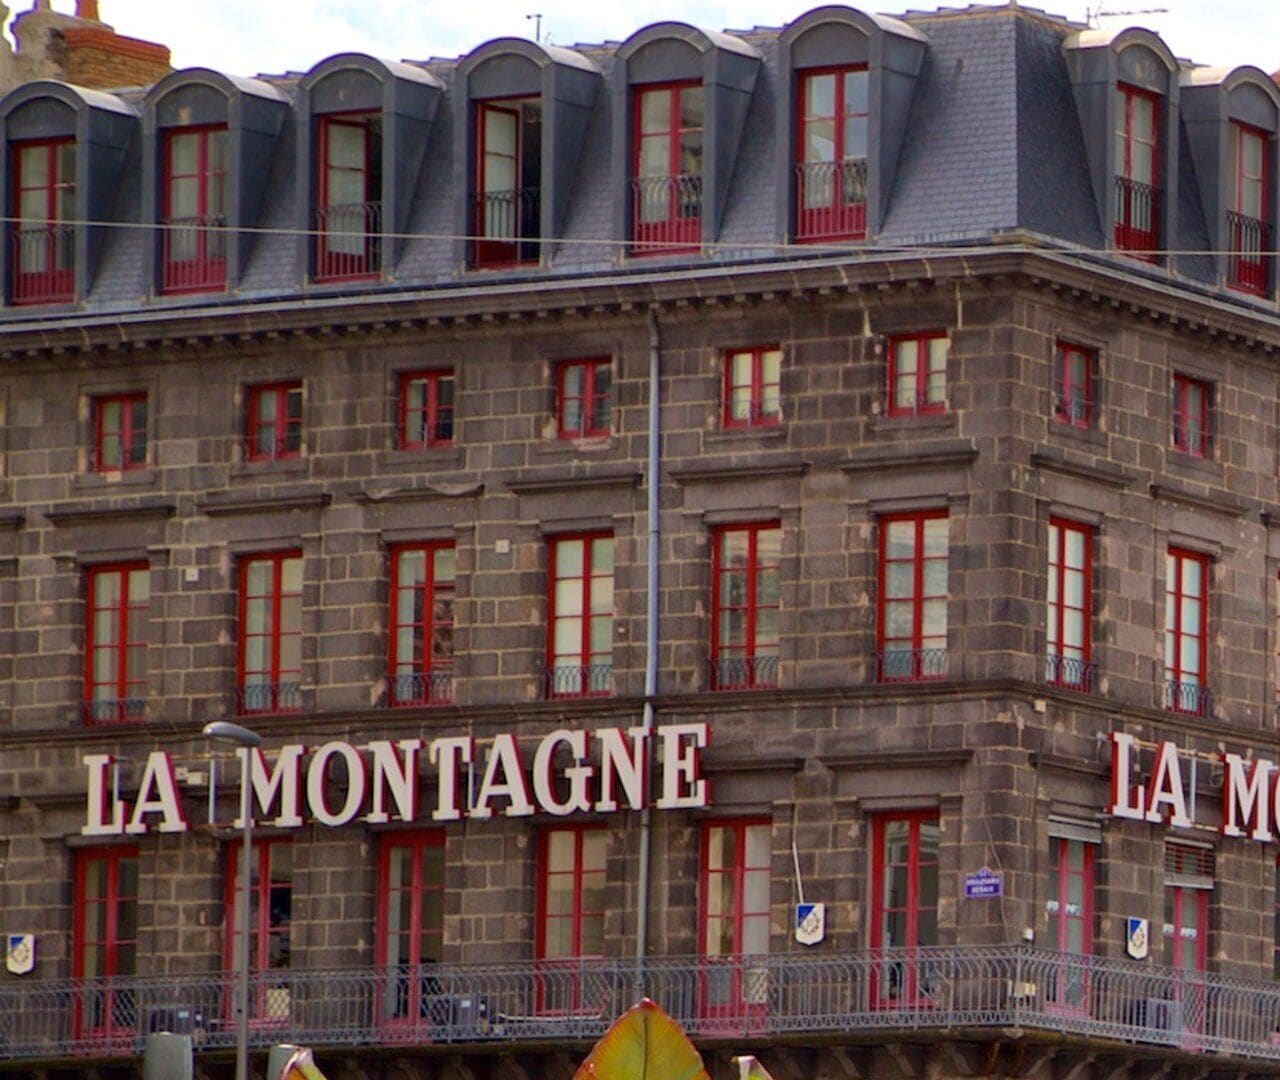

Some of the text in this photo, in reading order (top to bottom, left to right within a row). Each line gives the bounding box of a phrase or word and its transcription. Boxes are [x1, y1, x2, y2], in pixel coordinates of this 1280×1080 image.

[82, 723, 711, 836] LA MONTAGNE
[1111, 731, 1192, 828] LA
